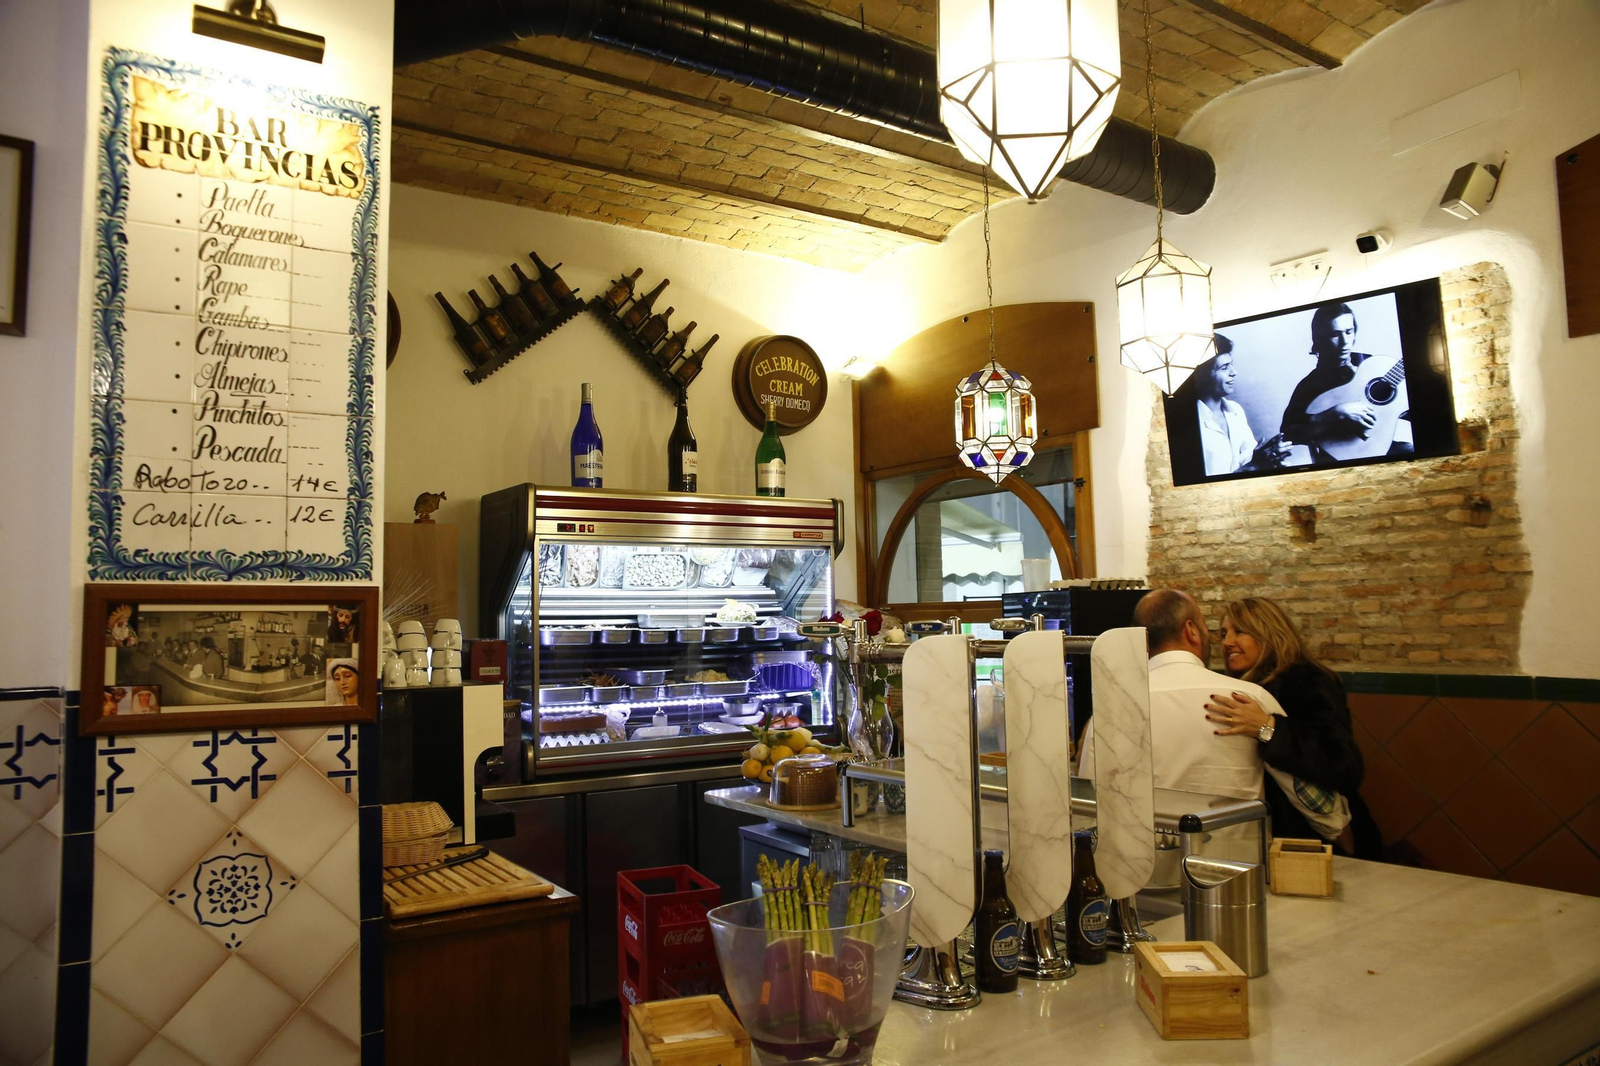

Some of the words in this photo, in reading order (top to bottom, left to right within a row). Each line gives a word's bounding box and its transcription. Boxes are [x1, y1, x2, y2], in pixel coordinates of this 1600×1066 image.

[215, 107, 288, 147] BAR
[139, 121, 360, 190] PROVINCIAS
[201, 181, 276, 218] Paella
[199, 208, 306, 248] Boquerones
[197, 237, 288, 272] Calamares
[197, 264, 248, 303] Rape
[198, 297, 269, 332] Gambas
[194, 326, 288, 365] Chipirones
[194, 360, 275, 396] Almejas
[755, 356, 820, 386] CELEBRATION
[769, 379, 803, 396] CREAM
[194, 390, 285, 427] Pinchitos
[760, 394, 785, 408] SHERRY
[785, 397, 811, 413] DOMECQ
[192, 424, 282, 464] Pescada
[290, 505, 335, 523] 12€
